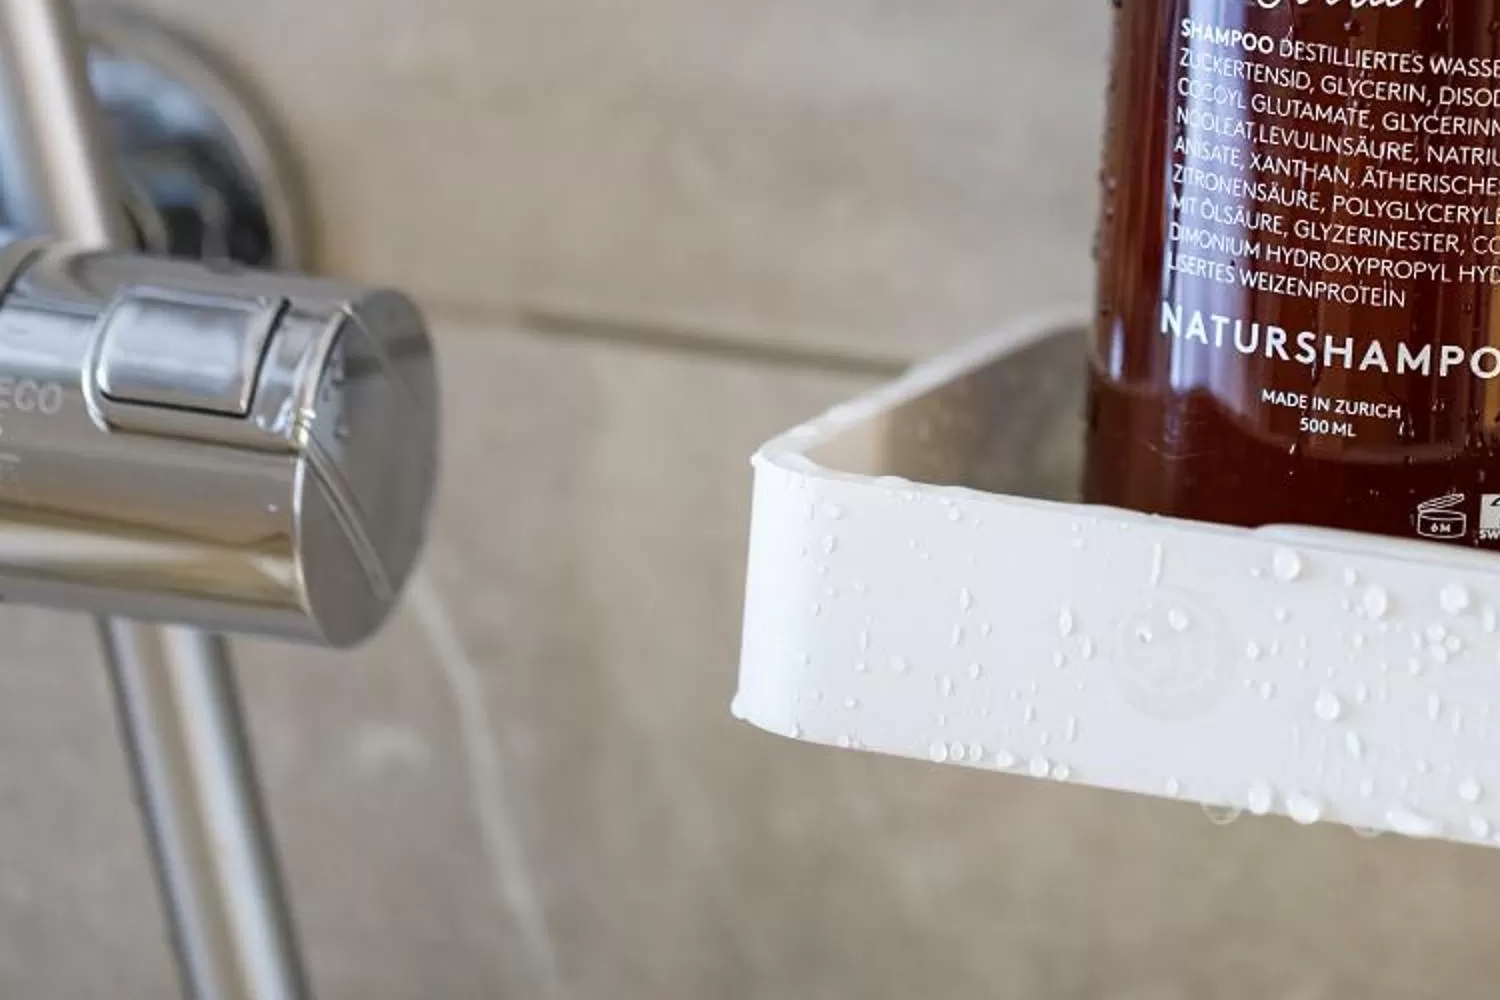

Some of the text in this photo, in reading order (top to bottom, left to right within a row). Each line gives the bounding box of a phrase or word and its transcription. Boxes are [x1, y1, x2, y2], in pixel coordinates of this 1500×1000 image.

[1181, 19, 1274, 54] SHAMPOO
[1279, 39, 1424, 74] DESTILLIERTES
[1180, 47, 1315, 94] ZUCKERTENSID,
[1321, 75, 1432, 107] GLYCERIN,
[1177, 77, 1247, 109] COCOYL
[1251, 94, 1375, 131] GLUTAMATE,
[1172, 163, 1325, 214] ZITRONENSÄURE,
[1249, 152, 1355, 188] XANTHAN,
[1200, 197, 1289, 238] ÖLSÄURE,
[1294, 219, 1465, 256] GLYZERINESTER,
[1169, 222, 1261, 260] DIMONIUM
[1265, 248, 1452, 284] HYDROXYPROPYL
[1239, 268, 1406, 308] WEIZENPROTEIN
[1261, 388, 1401, 419] MADE IN ZURICH
[1300, 417, 1357, 437] 500 ML
